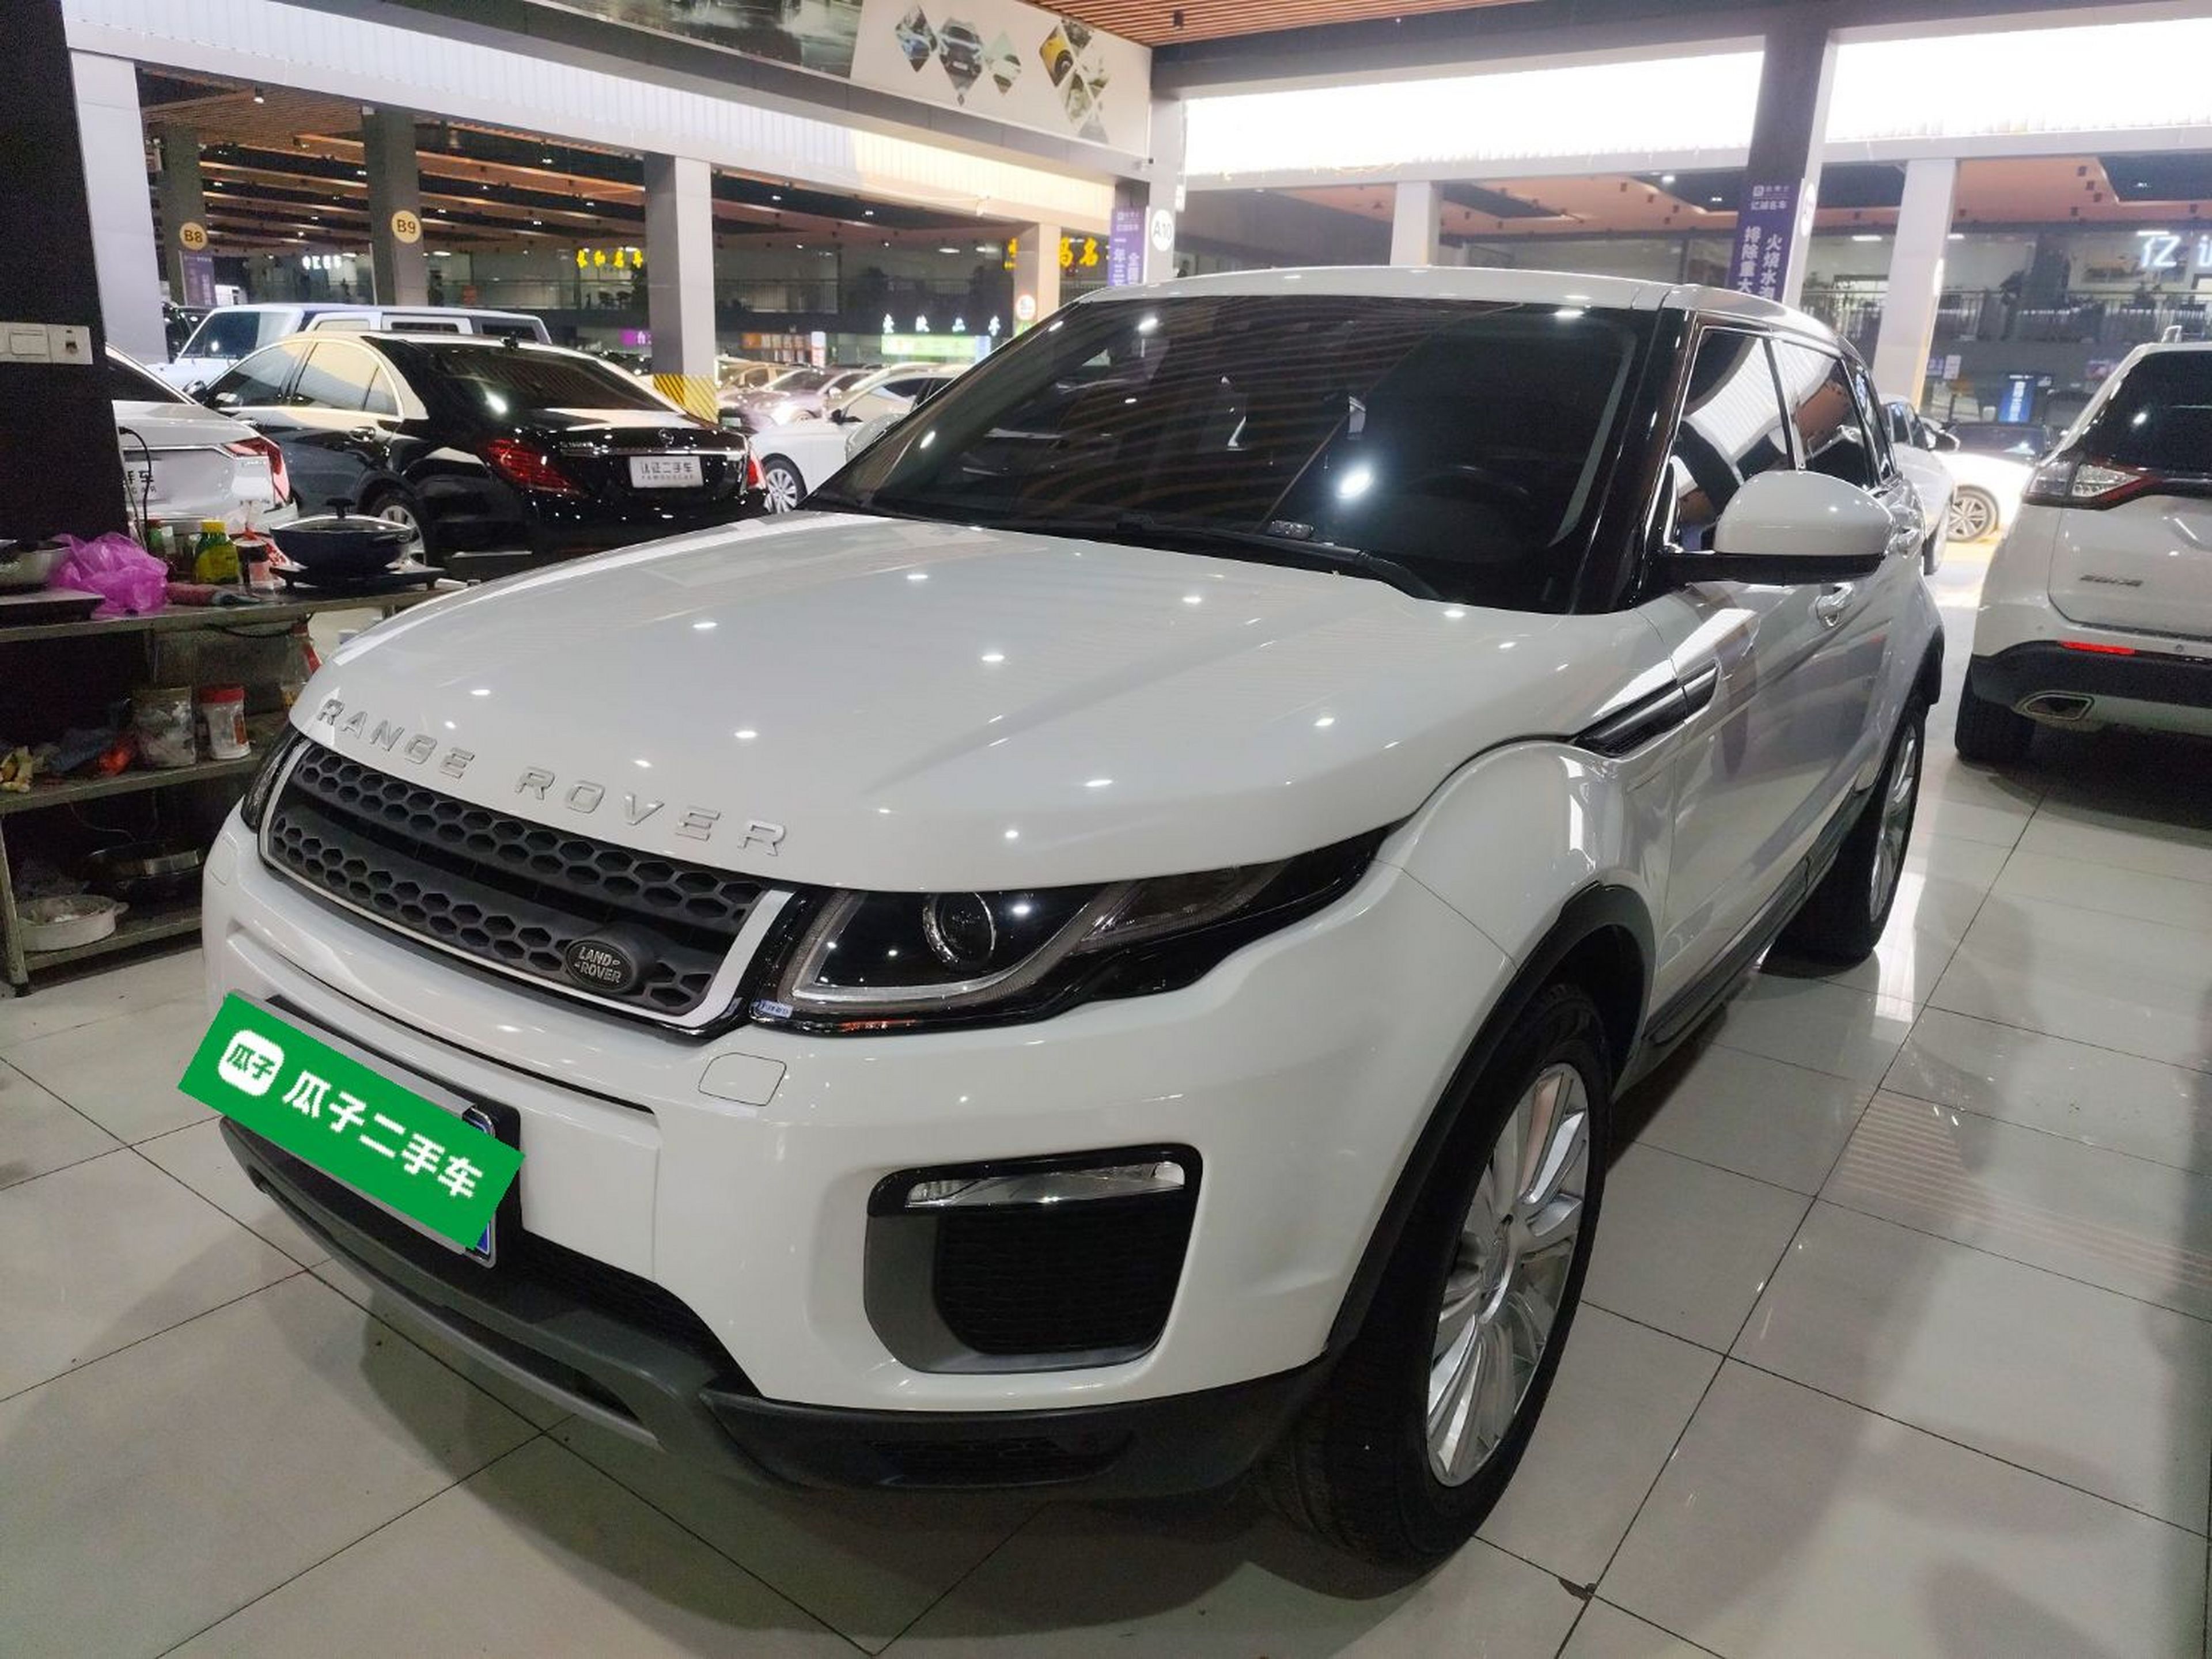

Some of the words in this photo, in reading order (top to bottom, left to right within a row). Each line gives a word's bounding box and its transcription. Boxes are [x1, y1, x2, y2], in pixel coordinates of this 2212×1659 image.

[184, 230, 203, 243] B8
[396, 219, 416, 234] B9
[1153, 220, 1173, 240] A10
[316, 699, 476, 779] RANGE
[514, 766, 787, 857] ROVER
[578, 946, 613, 967] LAND
[580, 961, 622, 983] ROVER
